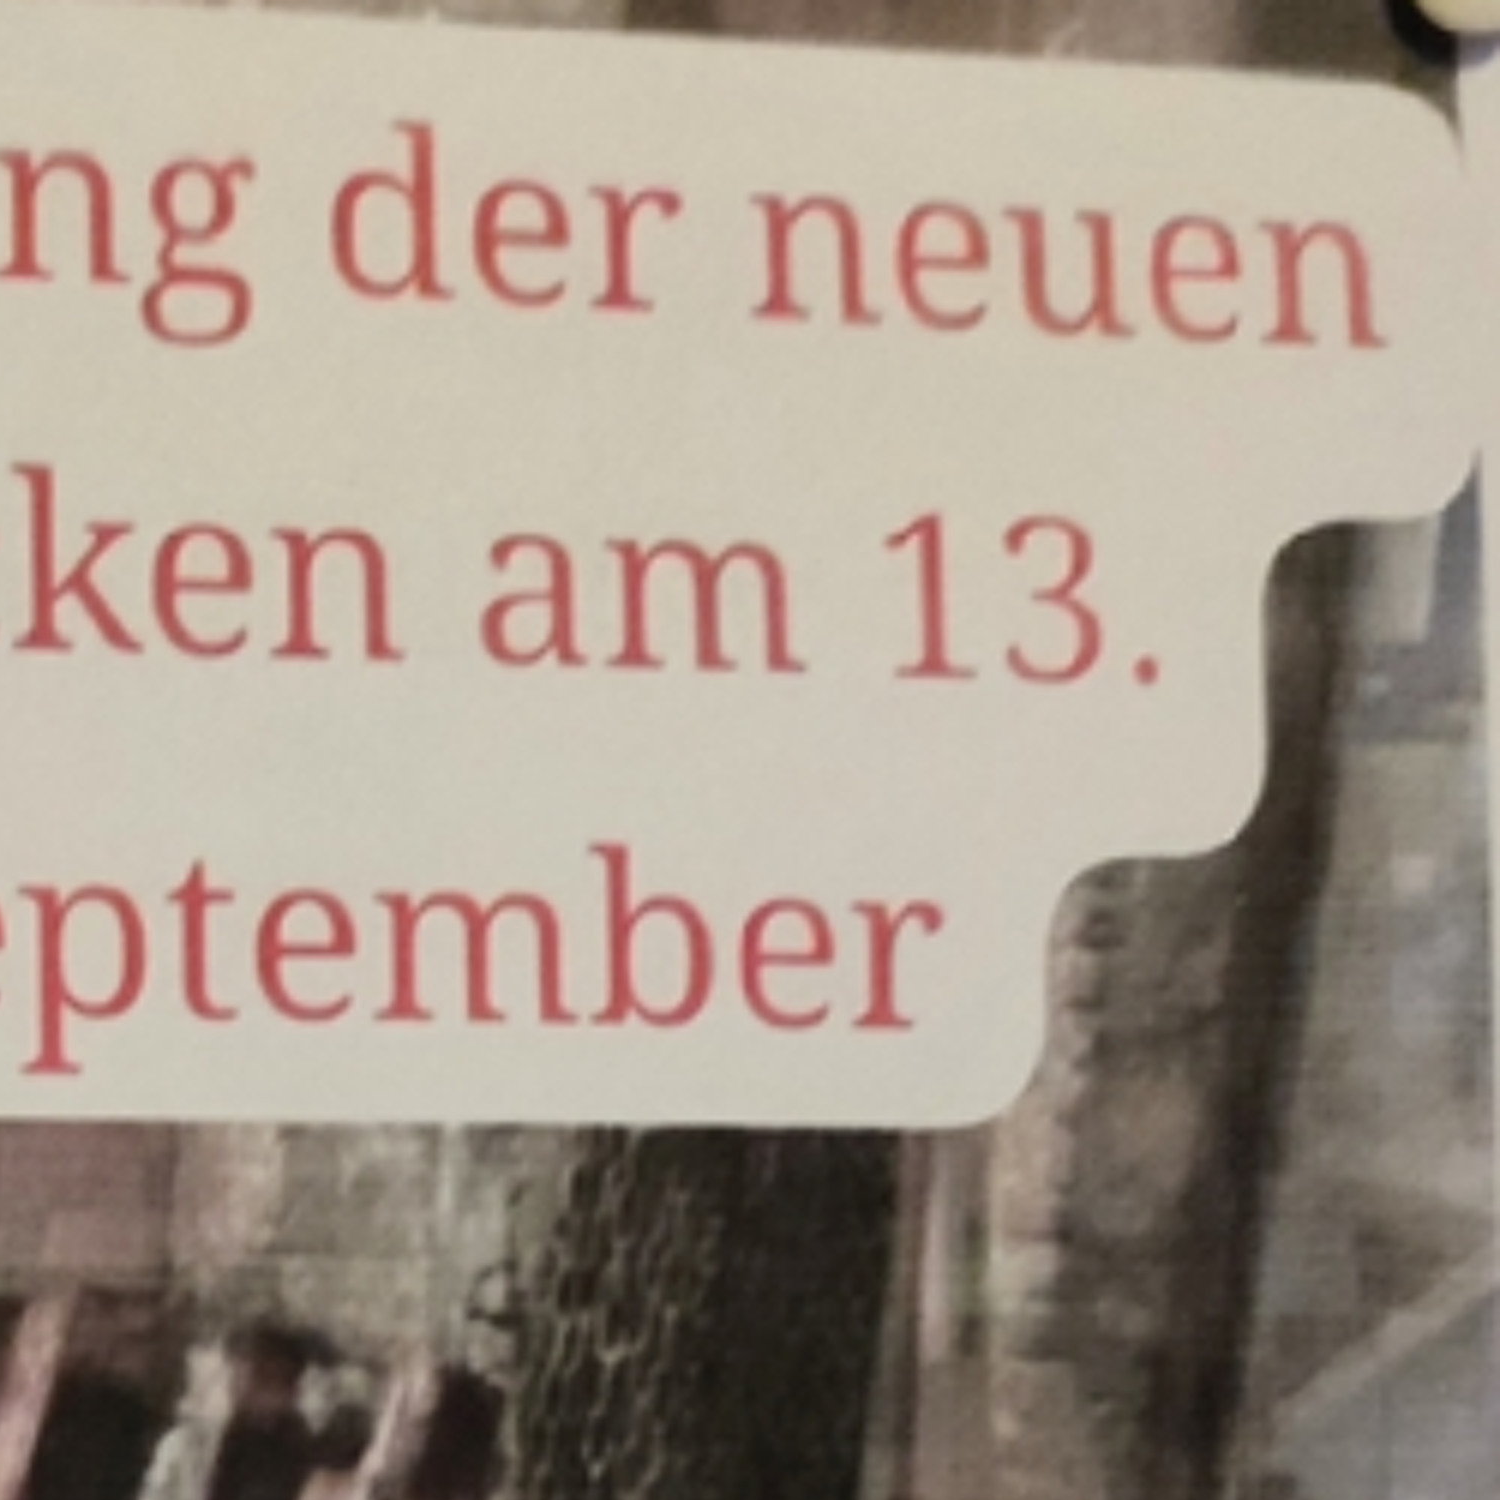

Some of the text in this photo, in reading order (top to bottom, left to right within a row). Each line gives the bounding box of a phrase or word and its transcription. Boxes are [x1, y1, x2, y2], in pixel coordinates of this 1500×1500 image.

[328, 119, 681, 313] der
[751, 192, 1385, 352] neuen
[479, 533, 807, 675] am
[883, 510, 1160, 688] 13.
